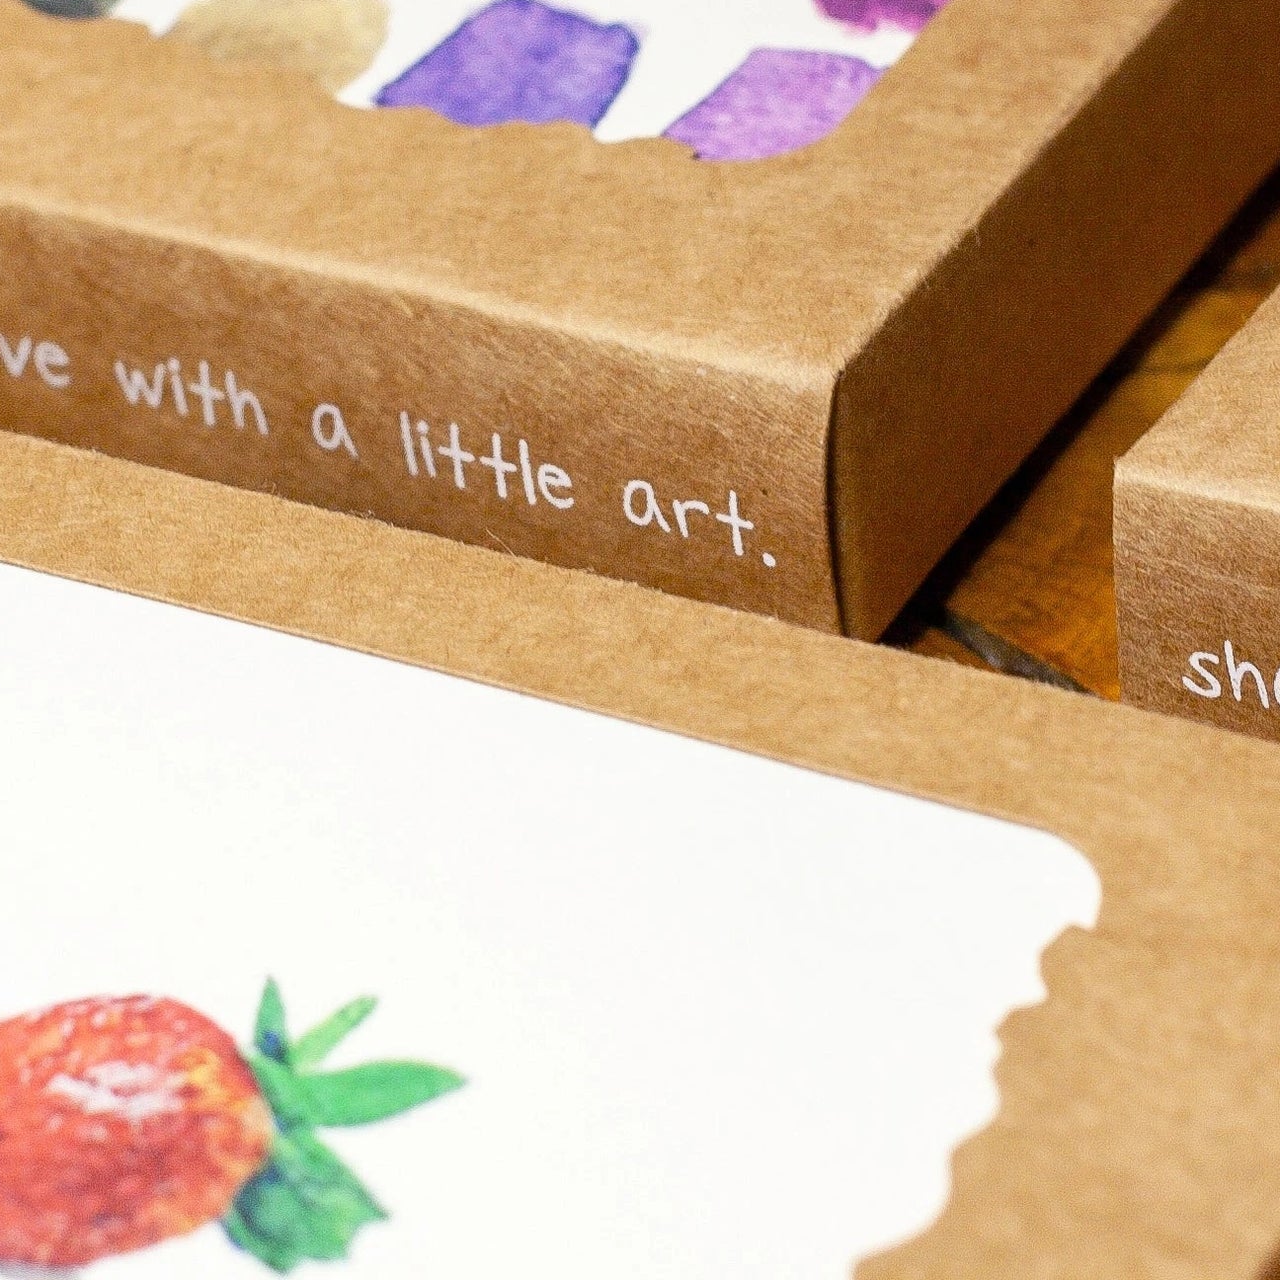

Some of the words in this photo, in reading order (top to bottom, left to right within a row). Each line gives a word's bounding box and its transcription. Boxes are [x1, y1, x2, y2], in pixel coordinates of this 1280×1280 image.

[115, 357, 269, 436] with
[312, 403, 359, 459] a
[400, 412, 575, 509] little
[623, 480, 778, 567] art.
